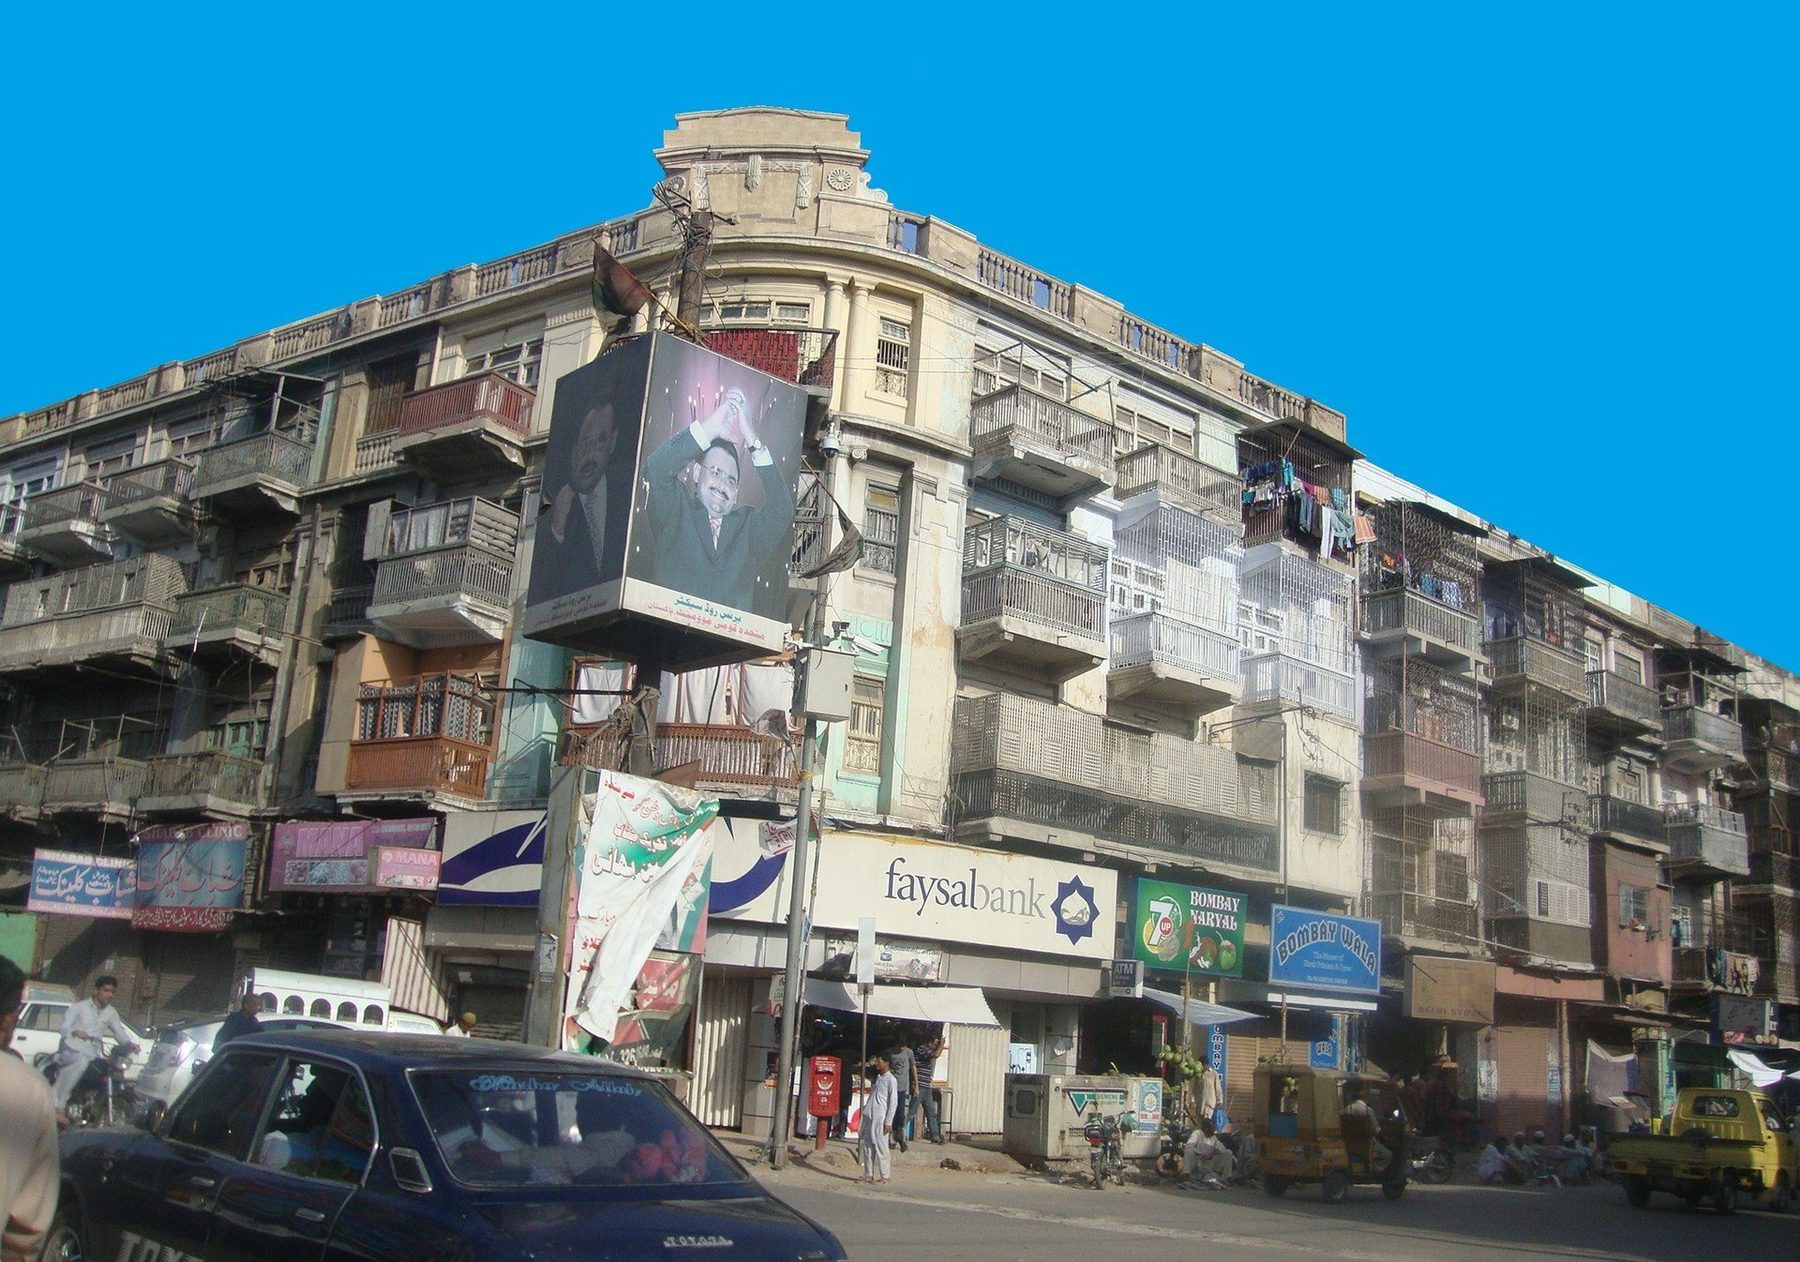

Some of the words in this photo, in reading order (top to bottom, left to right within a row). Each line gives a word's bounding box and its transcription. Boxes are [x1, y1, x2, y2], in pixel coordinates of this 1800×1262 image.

[674, 596, 703, 610] سیکٹر
[704, 602, 718, 617] روڈ
[395, 851, 438, 866] MANA
[884, 857, 1046, 919] faysalbank
[1190, 890, 1240, 913] BOMBAY
[1160, 920, 1171, 932] UP
[1190, 909, 1238, 931] NARYAL
[1276, 919, 1338, 966] BOMBAY
[1340, 924, 1376, 976] WALA
[1113, 963, 1133, 974] ATM
[1212, 1025, 1224, 1070] OMBAY
[666, 1236, 729, 1247] TOYOTA
